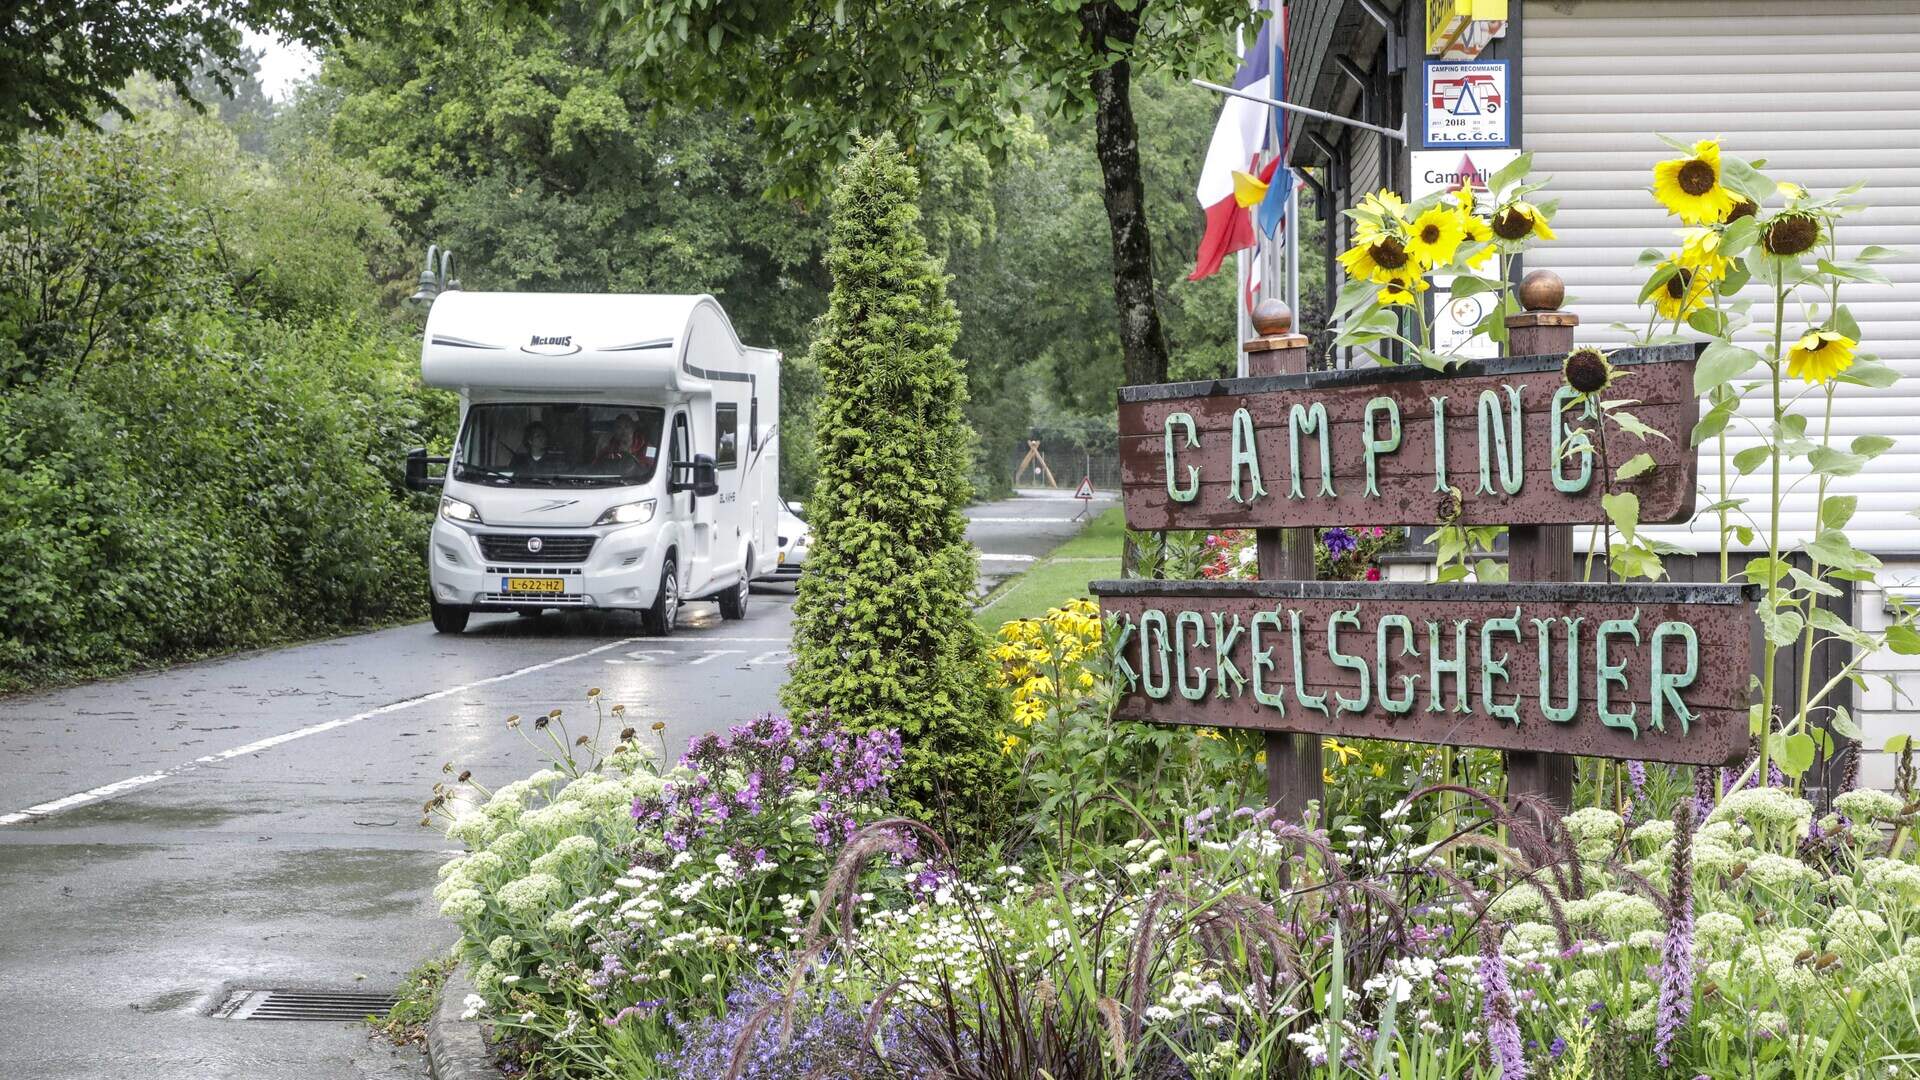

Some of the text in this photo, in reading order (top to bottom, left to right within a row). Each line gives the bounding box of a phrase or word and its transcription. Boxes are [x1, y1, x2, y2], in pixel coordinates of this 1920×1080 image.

[1431, 132, 1504, 141] F.L.C.C.C.
[1424, 168, 1492, 188] Campril
[1164, 384, 1598, 503] CAMPING
[511, 579, 560, 590] L-622-HZ
